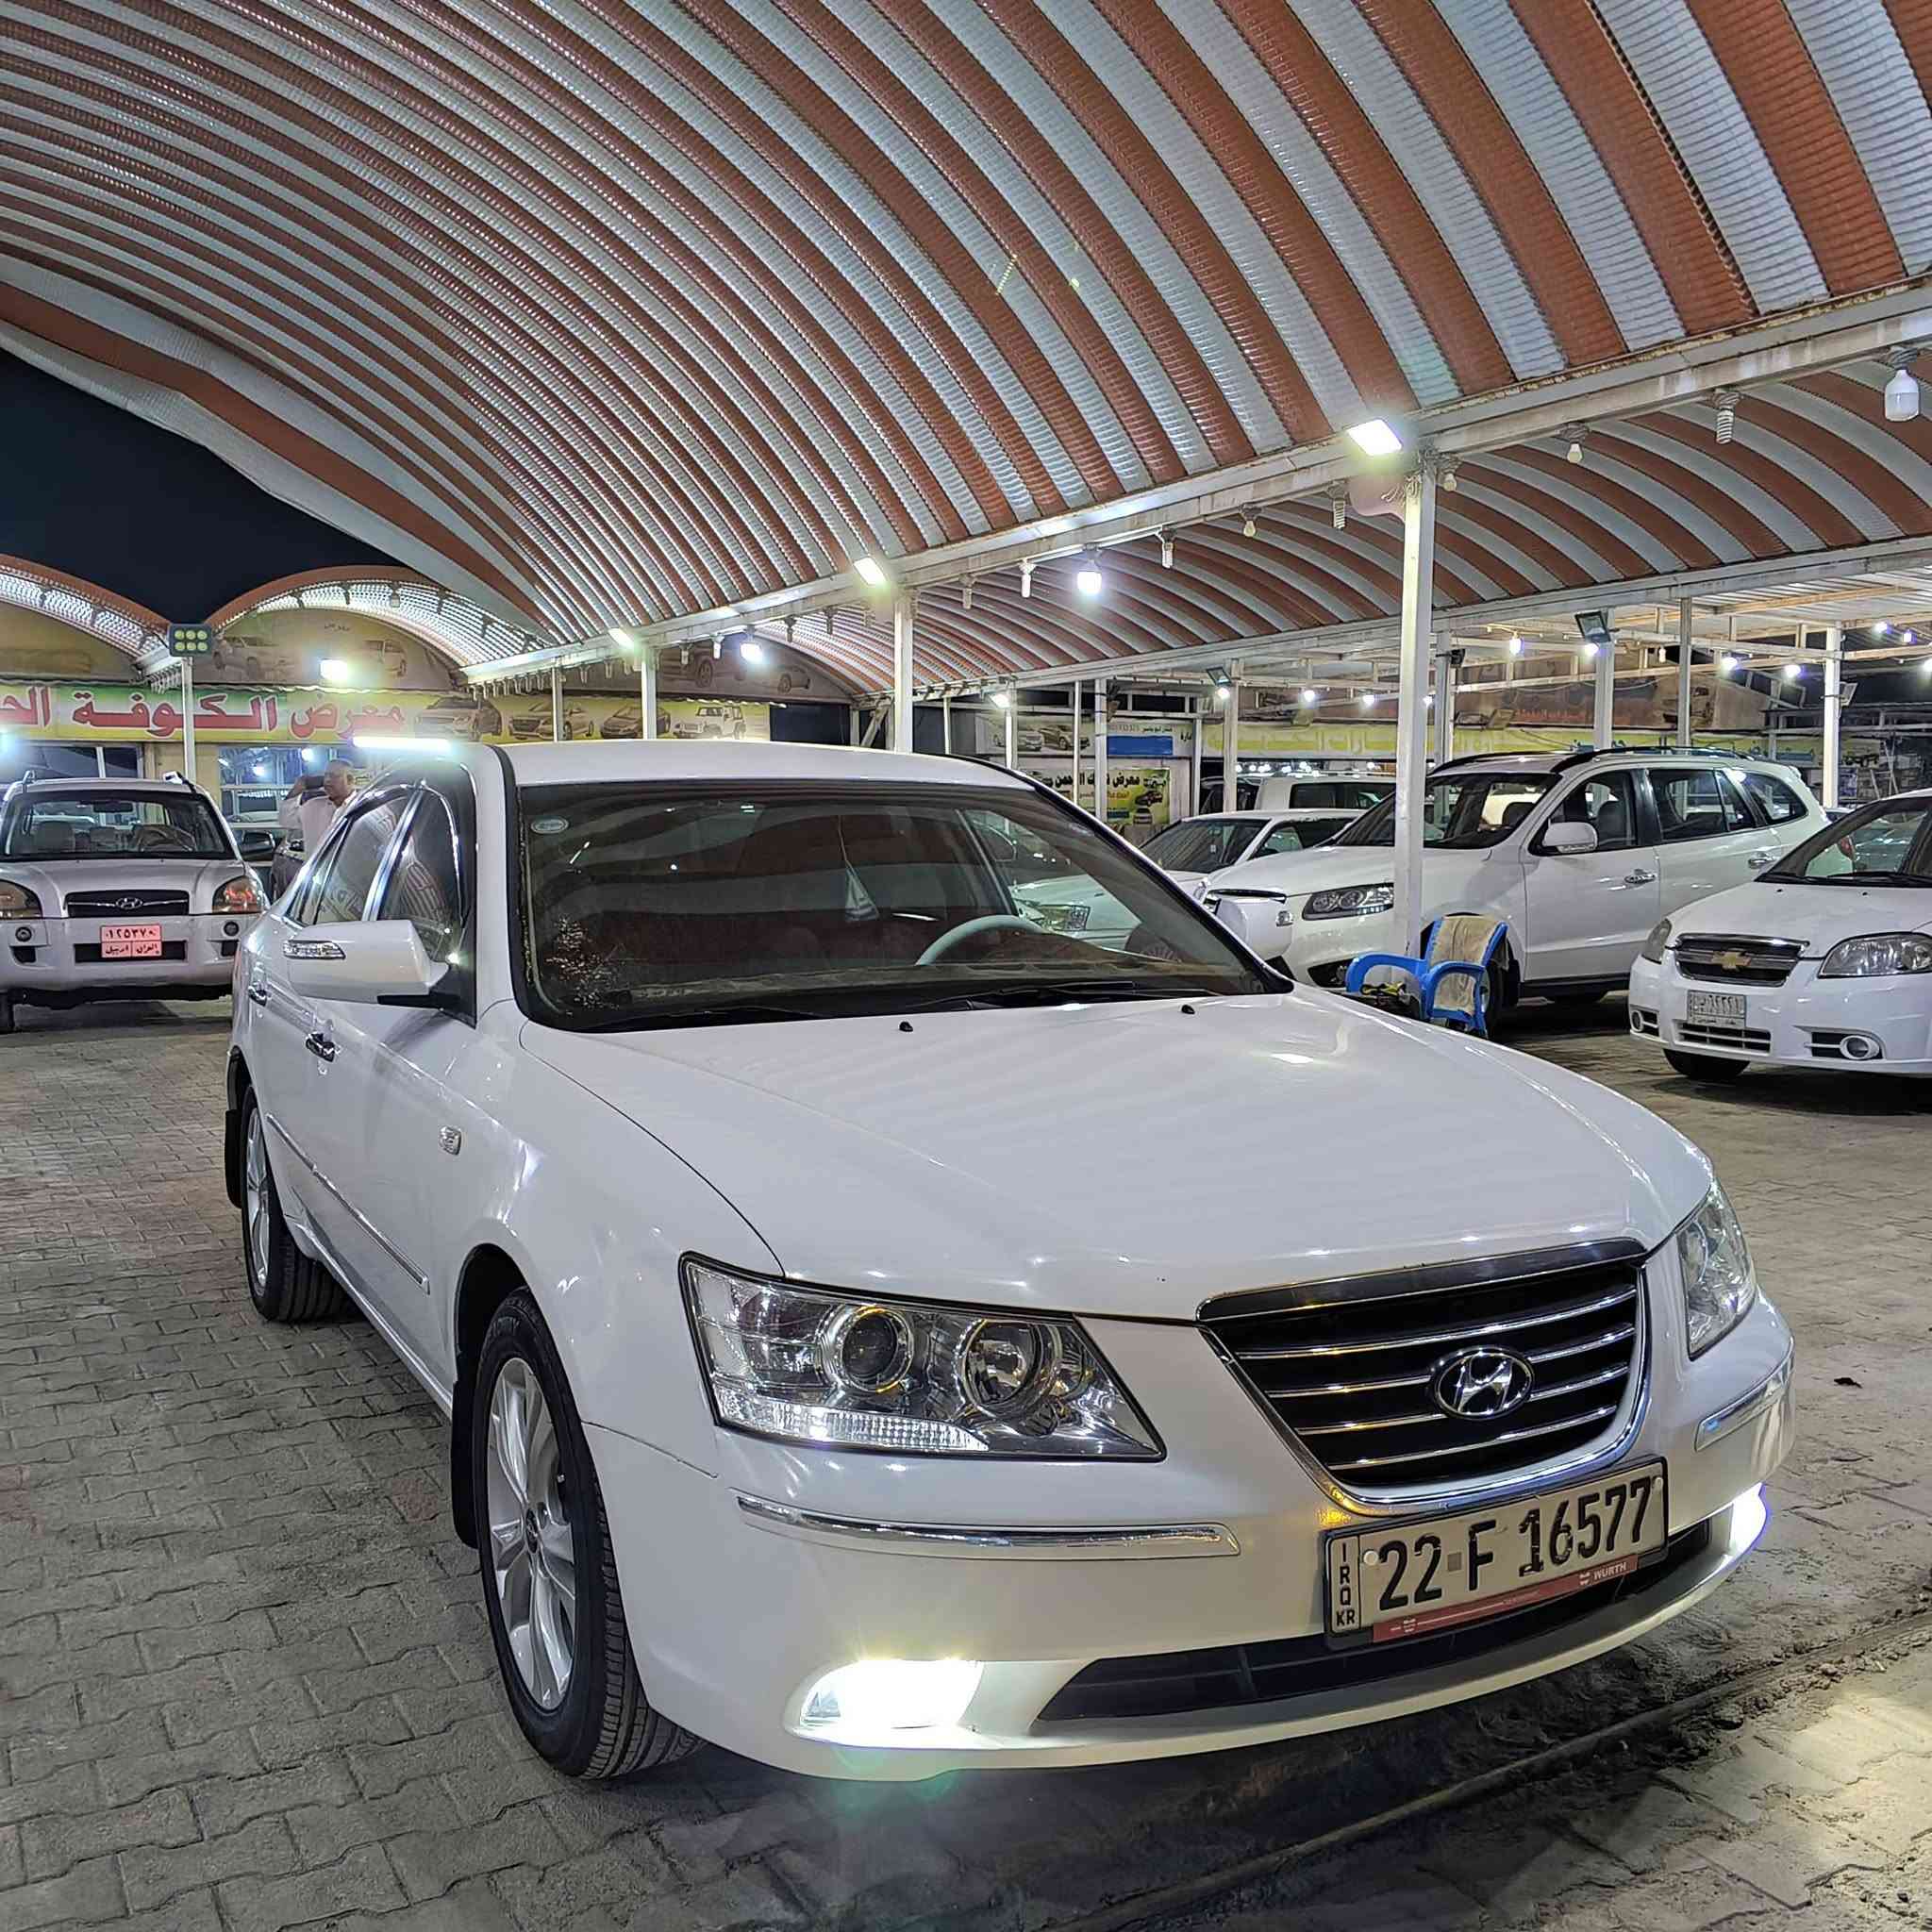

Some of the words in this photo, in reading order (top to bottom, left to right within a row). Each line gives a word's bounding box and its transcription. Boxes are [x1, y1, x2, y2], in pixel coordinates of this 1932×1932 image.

[72, 691, 277, 737] الكوفة
[291, 693, 406, 740] معرض
[1112, 773, 1140, 788] معرض
[1378, 1534, 1442, 1611] 22
[1468, 1519, 1497, 1591] F
[1518, 1475, 1652, 1577] 16577
[1339, 1541, 1352, 1606] IRQ
[1335, 1608, 1356, 1627] KR
